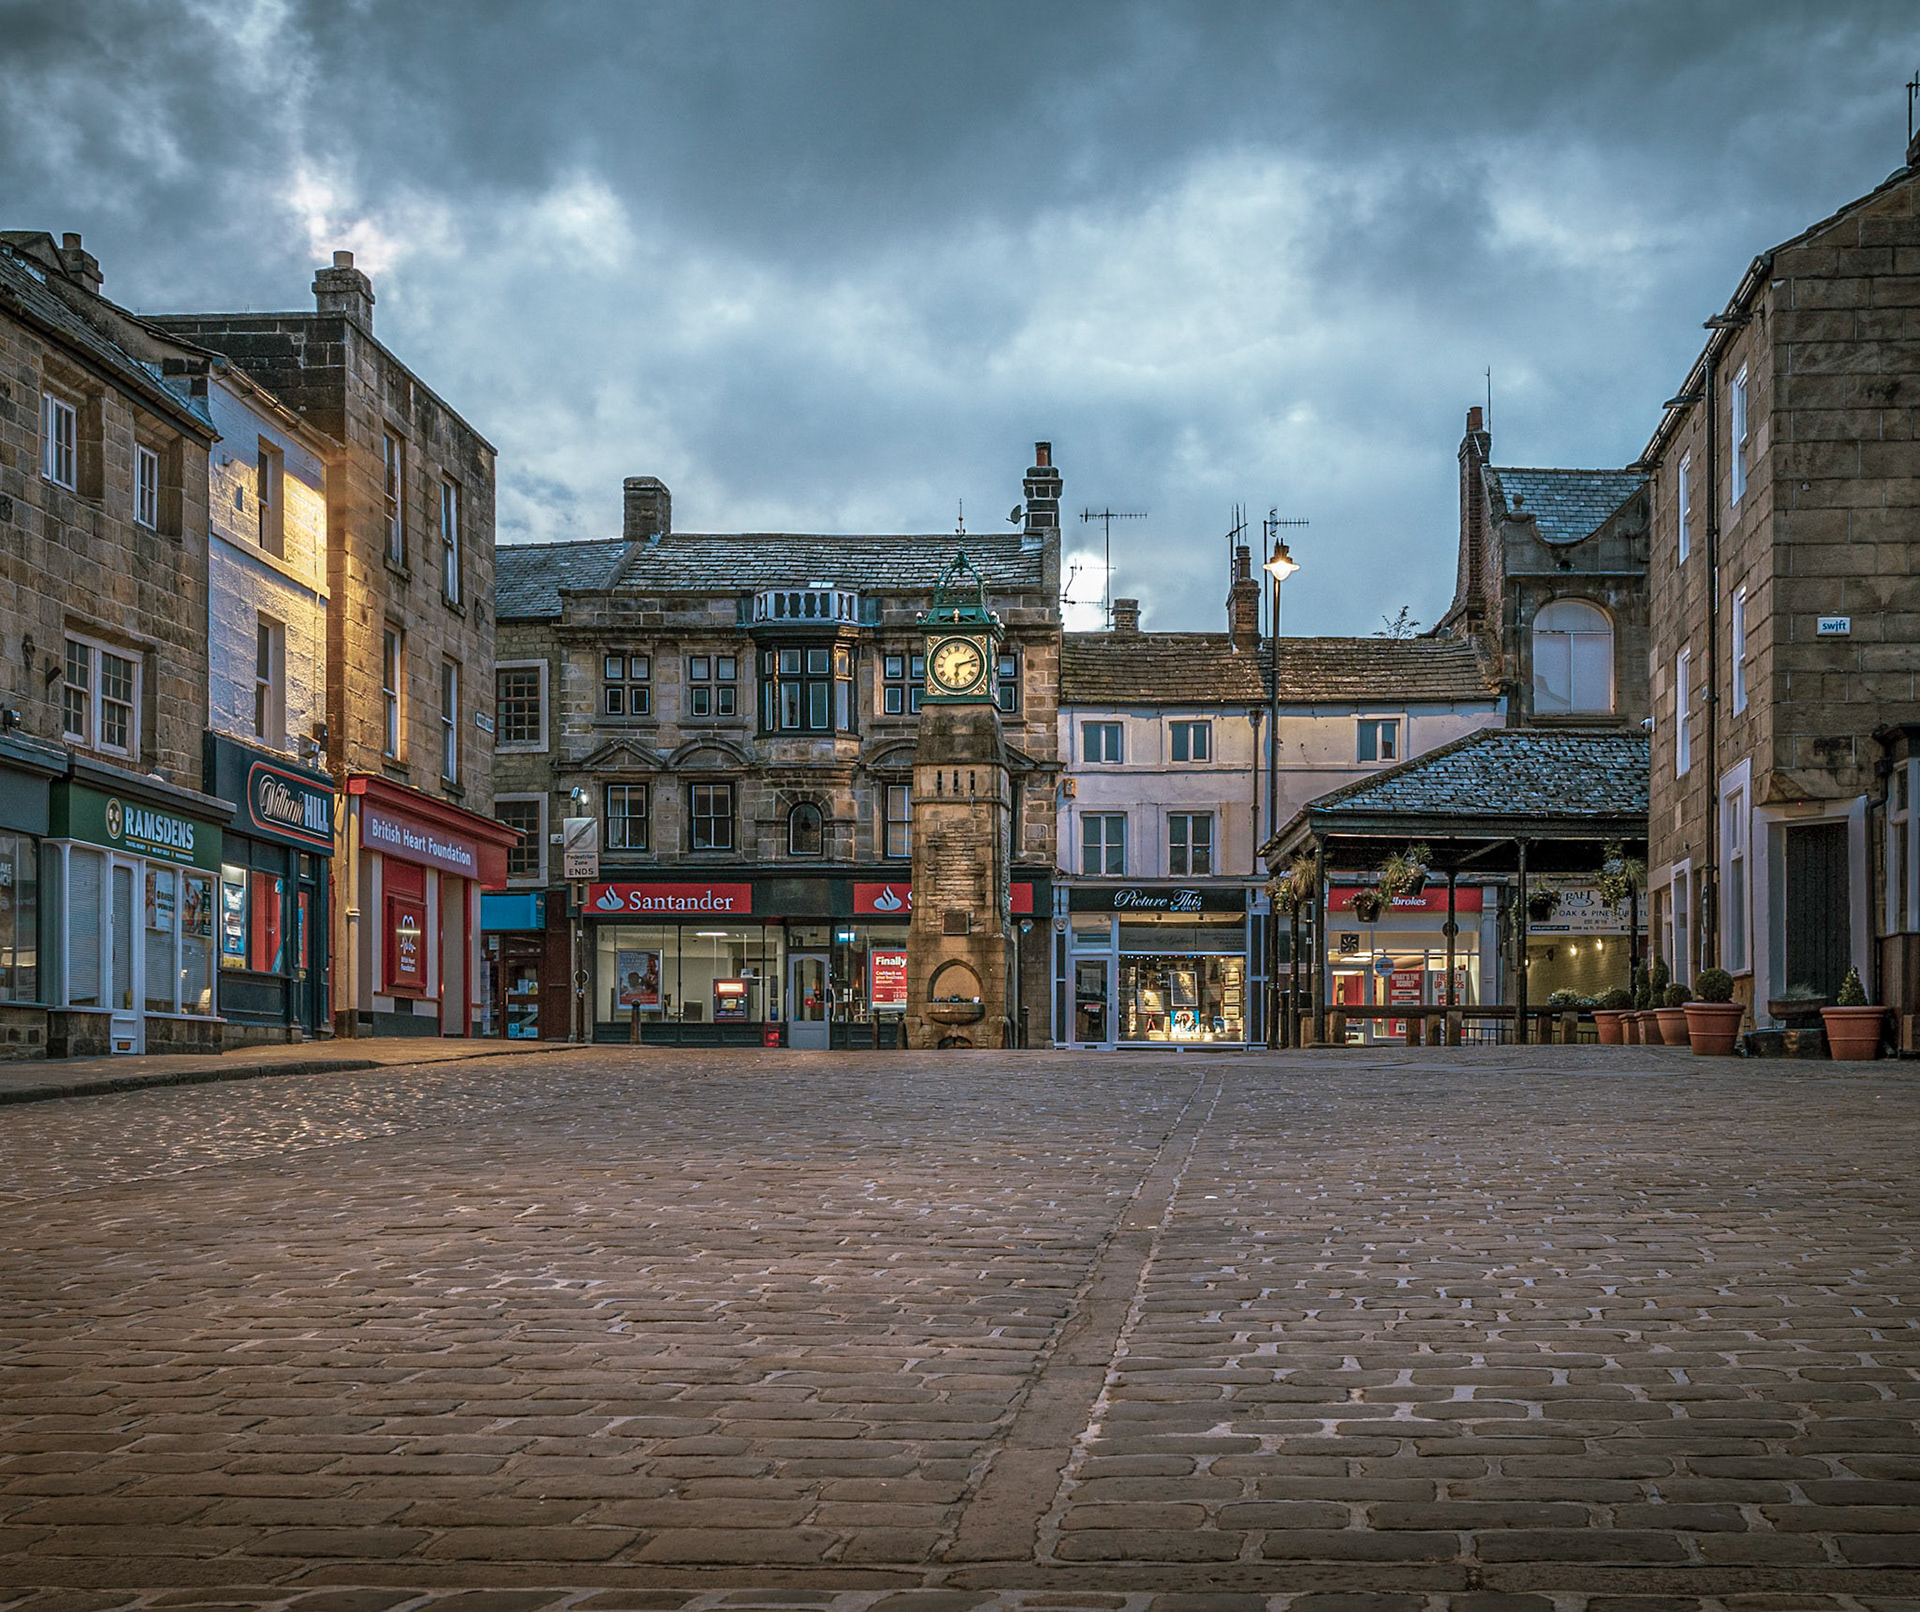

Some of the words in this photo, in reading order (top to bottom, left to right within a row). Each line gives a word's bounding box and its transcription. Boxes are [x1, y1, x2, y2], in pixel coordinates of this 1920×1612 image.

[1822, 620, 1846, 632] swift
[259, 775, 304, 825] William
[305, 793, 329, 833] HILL
[125, 806, 194, 850] RAMSDENS
[372, 818, 400, 844] British
[403, 828, 426, 852] Heart
[428, 837, 471, 866] Foundation
[569, 867, 594, 876] ENDS
[629, 889, 734, 911] Santander
[1114, 888, 1168, 908] Picture
[1170, 888, 1203, 907] This
[1562, 890, 1595, 901] RAFT
[1581, 909, 1588, 917] &
[1591, 909, 1609, 917] PINE
